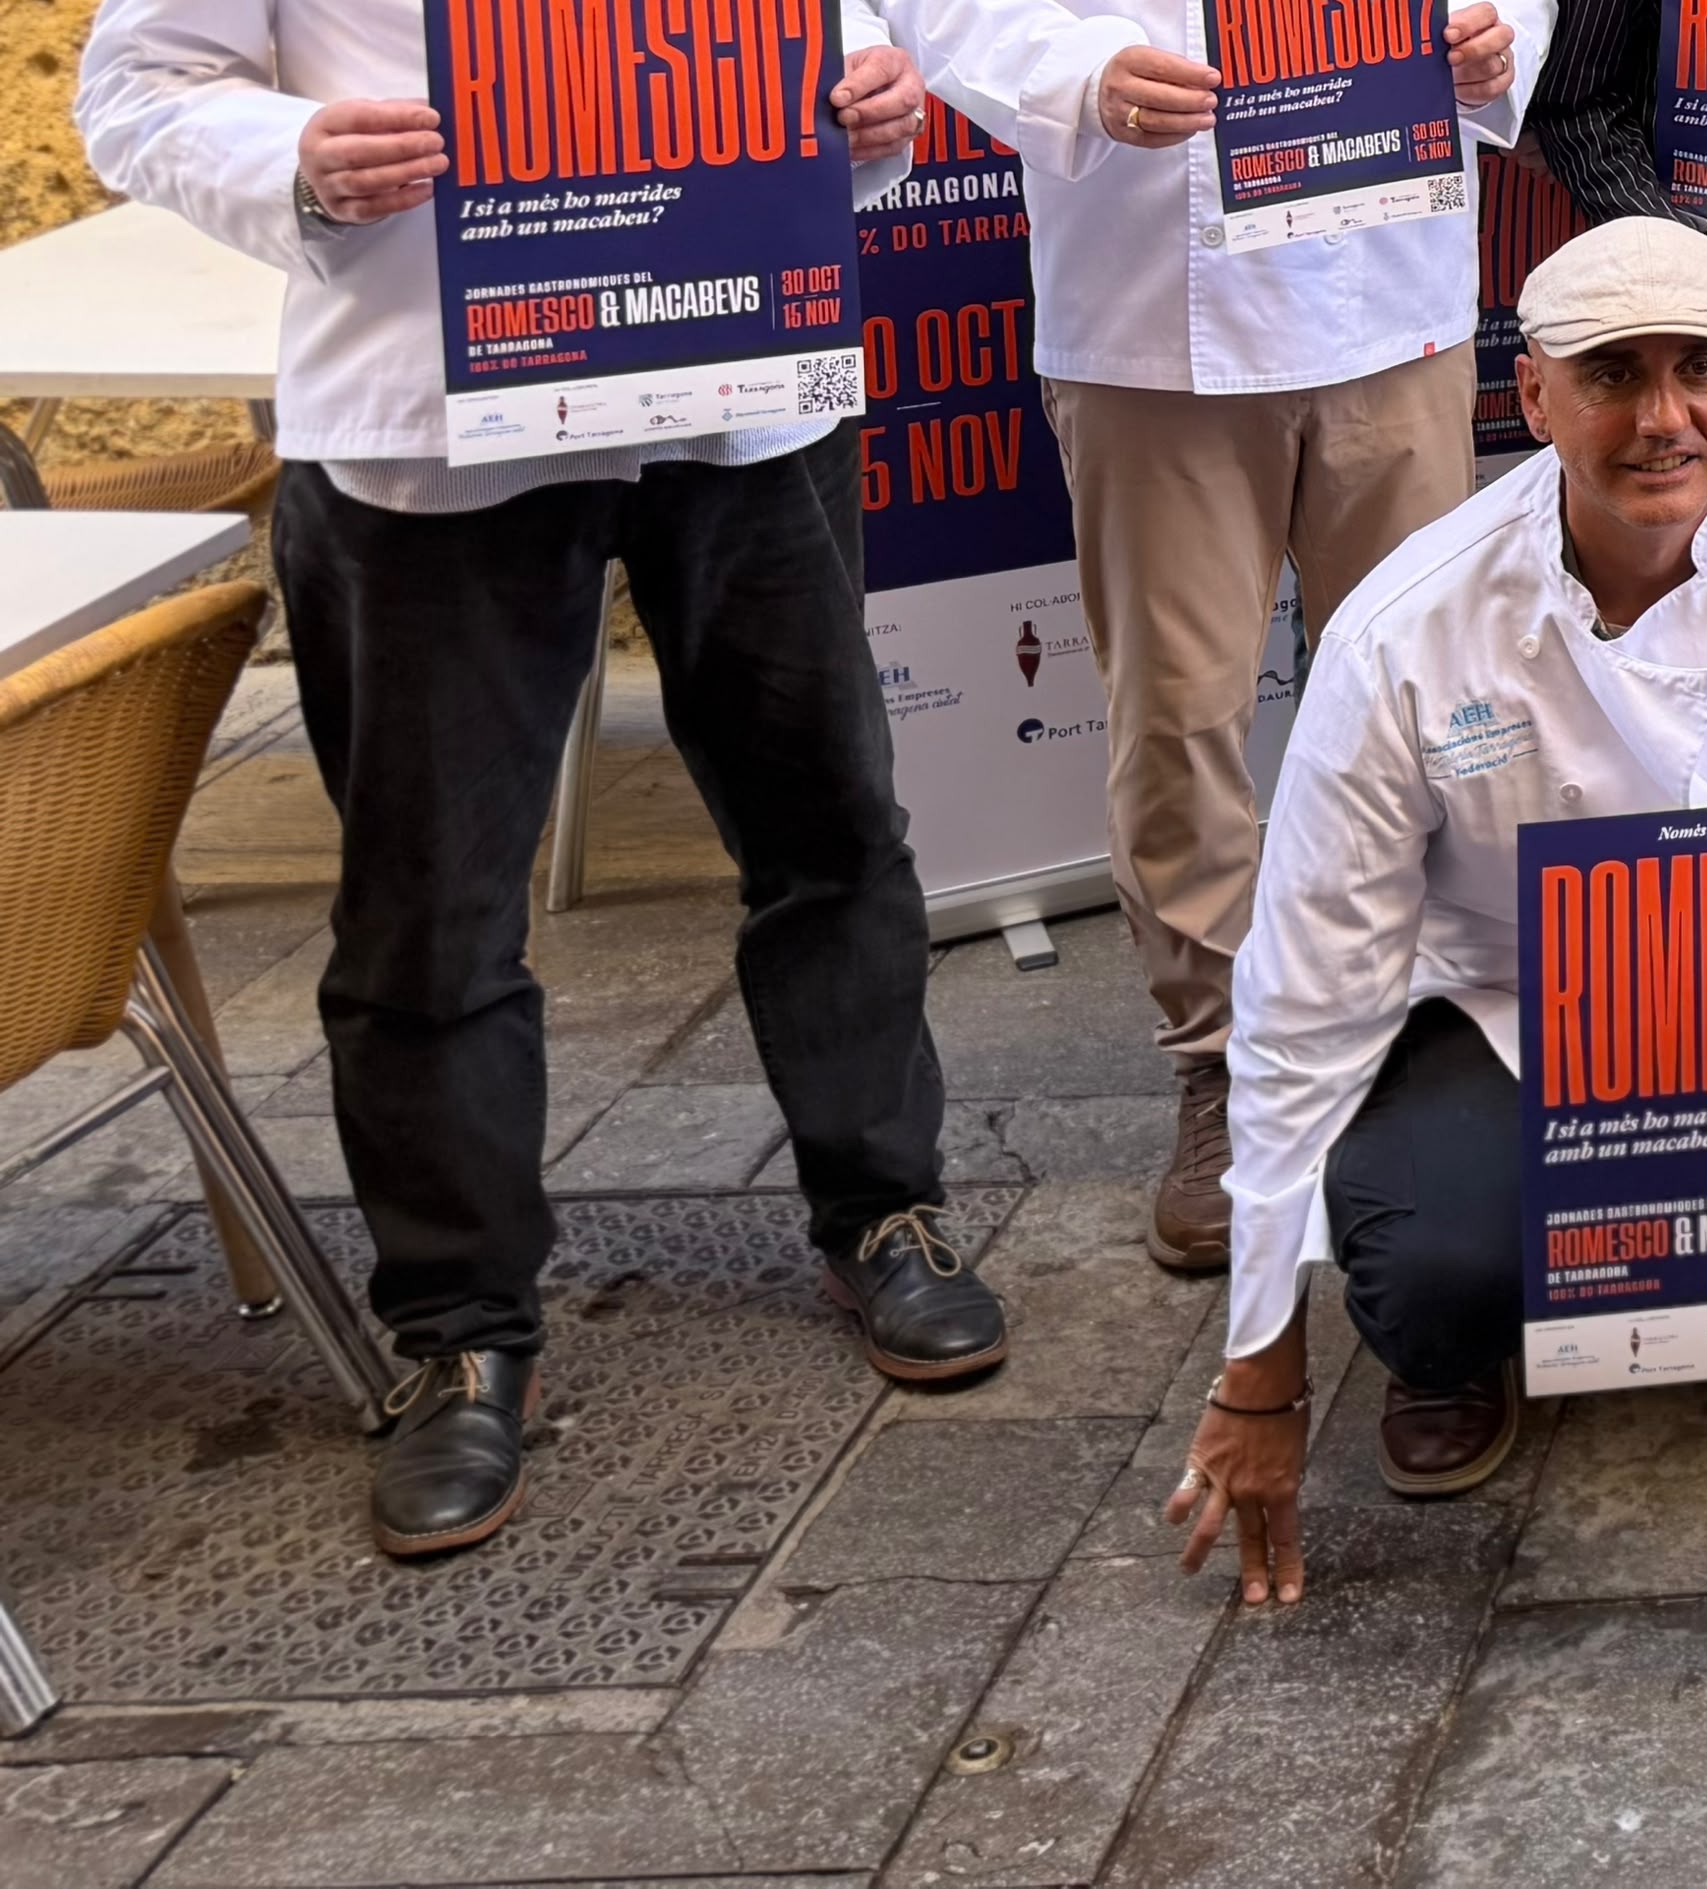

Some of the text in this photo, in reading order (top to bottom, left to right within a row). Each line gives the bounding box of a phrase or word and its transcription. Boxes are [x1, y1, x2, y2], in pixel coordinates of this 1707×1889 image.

[1231, 129, 1400, 181] ROMESCO & MACABEVS
[460, 184, 682, 218] I si a més bo marides
[864, 170, 1019, 212] ARRAGONA
[460, 206, 664, 241] amb un macabeu?
[892, 212, 1031, 252] DO TARRA
[809, 265, 842, 294] OCT
[467, 276, 760, 341] ROMESCO & MACABEVS
[805, 296, 842, 327] NOV
[862, 298, 1025, 399] 0 OCT
[859, 426, 891, 511] 5
[908, 407, 1022, 504] NOV
[1046, 635, 1089, 651] TARRA
[879, 666, 910, 687] EH
[1048, 723, 1081, 740] Port
[1658, 826, 1707, 840] Només
[1544, 1120, 1557, 1140] I
[1558, 1118, 1578, 1139] si
[1579, 1121, 1593, 1135] a
[1600, 1113, 1639, 1134] més
[1643, 1111, 1668, 1130] bo
[1545, 1141, 1594, 1163] amb
[1599, 1143, 1627, 1158] un
[1546, 1218, 1669, 1269] ROMESCO
[1675, 1216, 1694, 1256] &
